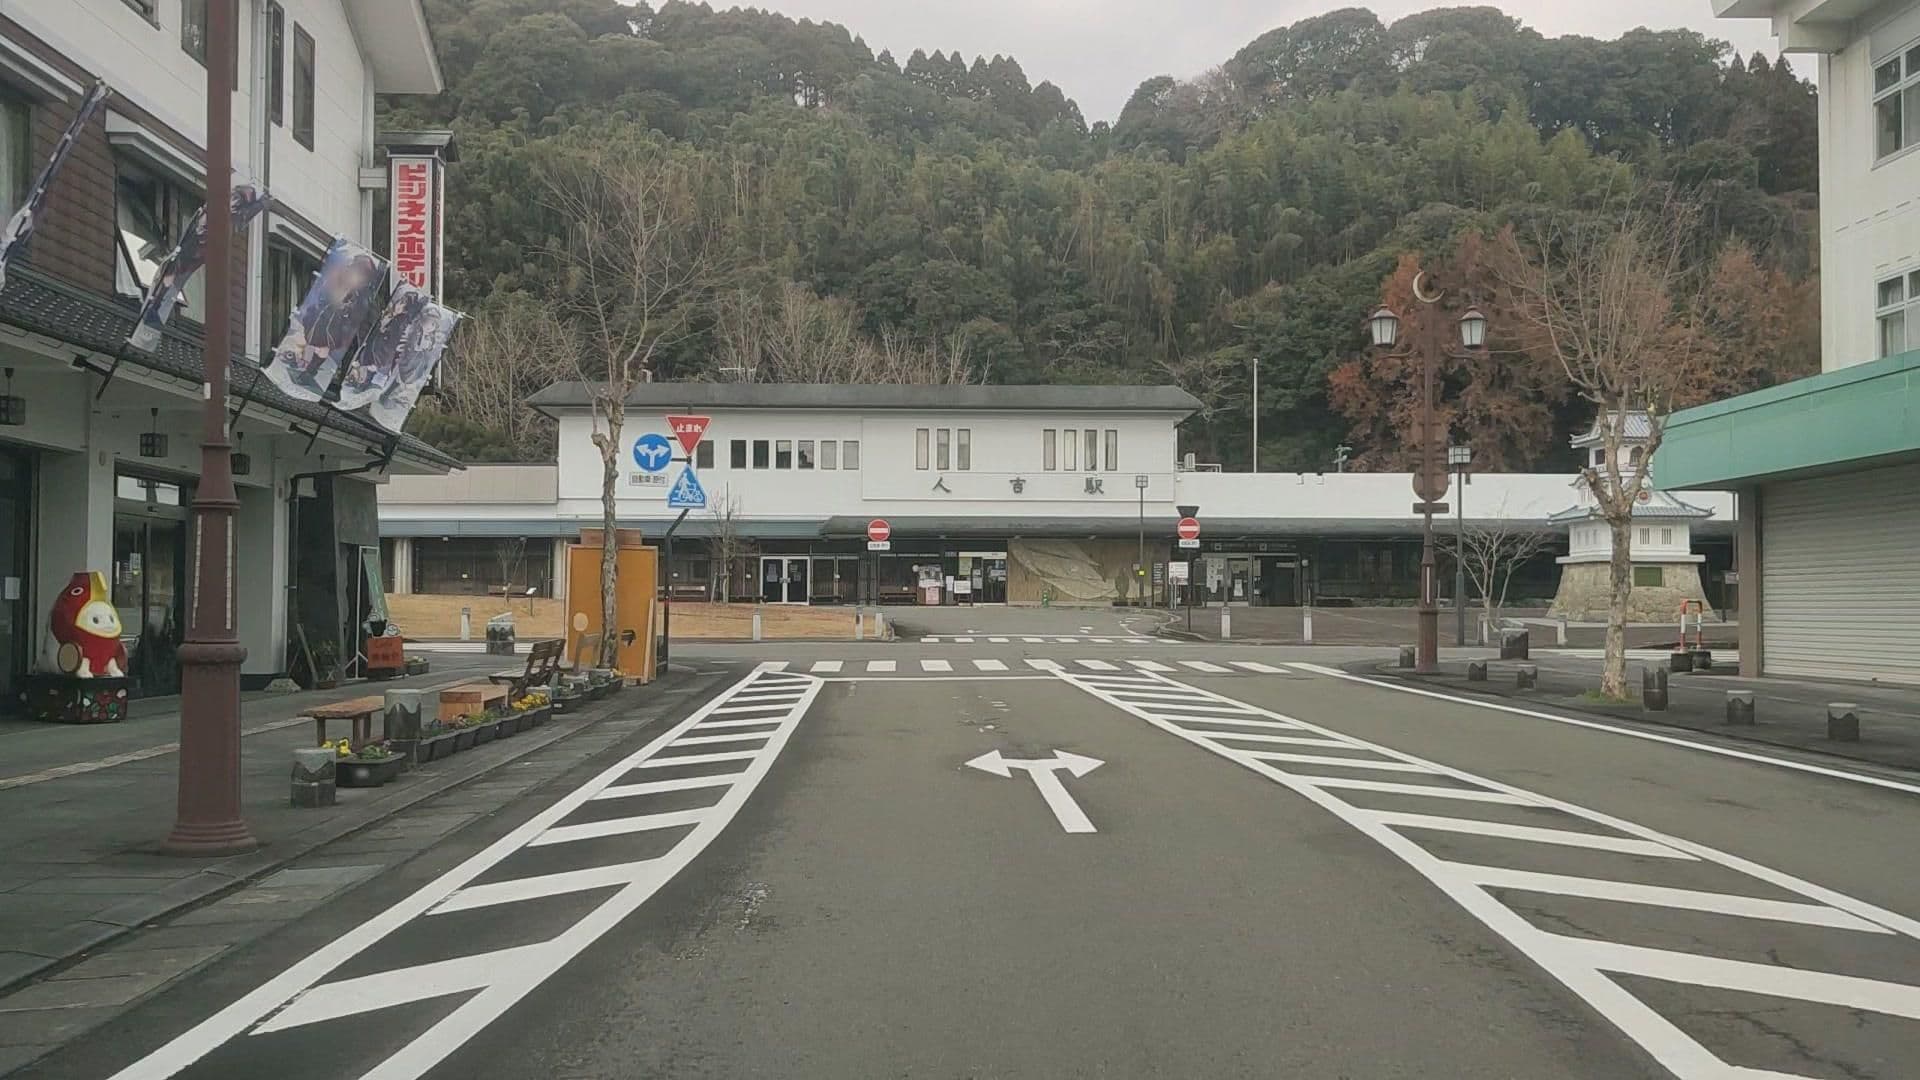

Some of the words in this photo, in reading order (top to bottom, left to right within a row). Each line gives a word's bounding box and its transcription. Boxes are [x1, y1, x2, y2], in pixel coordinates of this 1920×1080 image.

[676, 423, 703, 433] 止まれ
[932, 476, 1105, 495] 人吉駅
